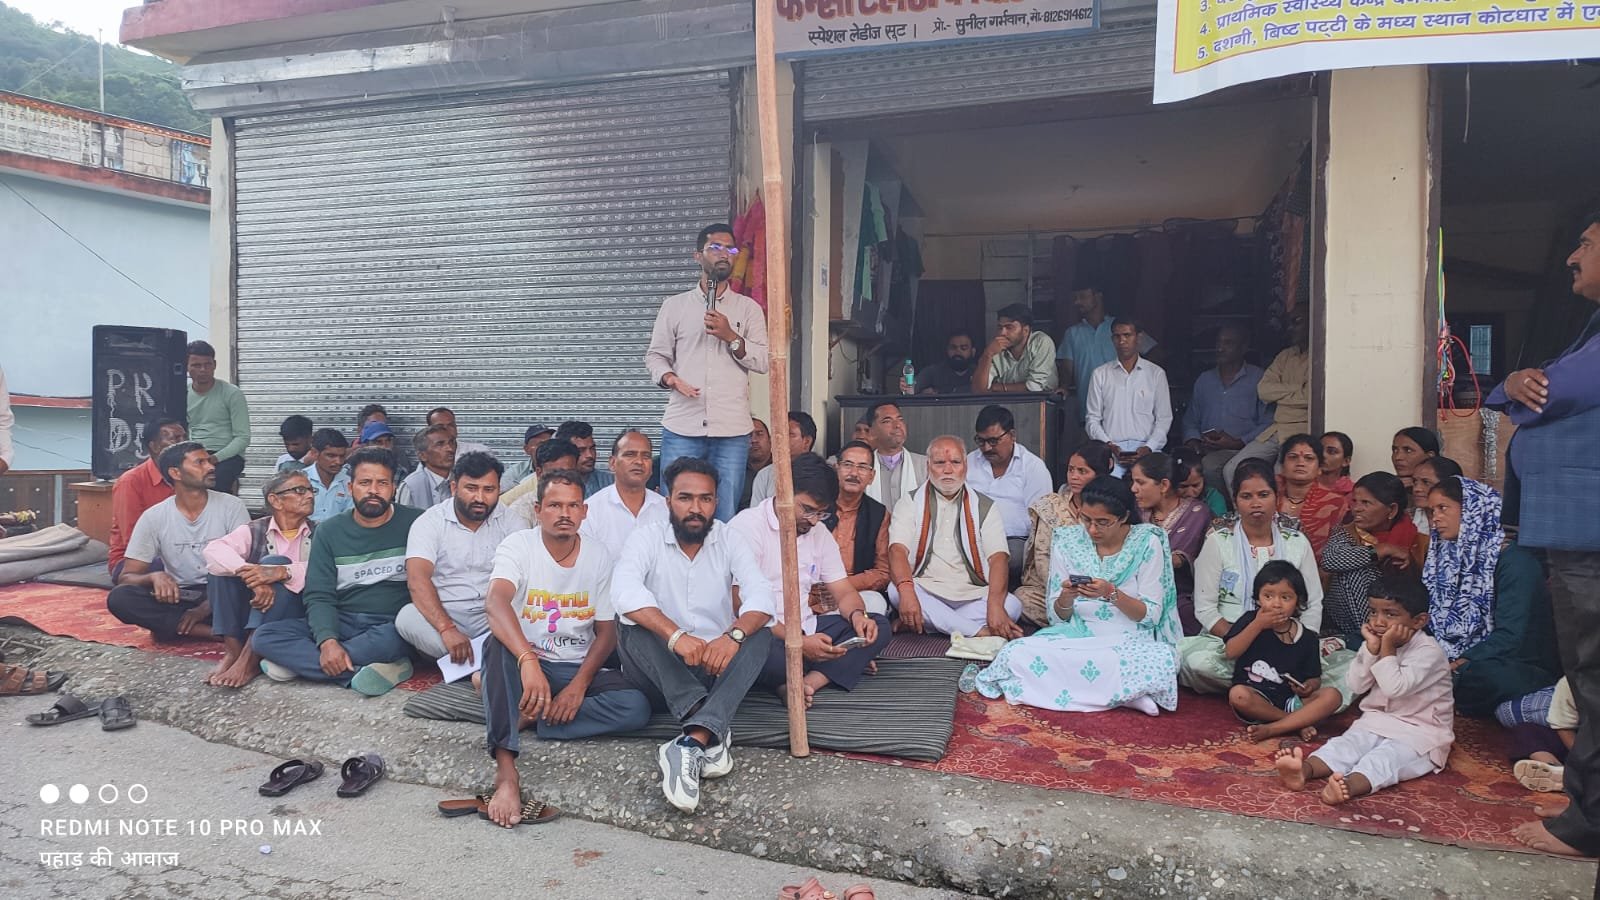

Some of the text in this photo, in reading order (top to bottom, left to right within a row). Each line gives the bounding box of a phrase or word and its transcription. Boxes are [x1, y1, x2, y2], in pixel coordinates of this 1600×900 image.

[956, 13, 986, 35] सुनील
[1217, 3, 1278, 29] प्राथमिक
[1264, 22, 1301, 40] बिष्ट
[1353, 13, 1371, 31] के
[1377, 16, 1417, 30] मध्य
[1423, 13, 1471, 27] स्थान
[1478, 6, 1550, 24] कोटधार
[1556, 1, 1575, 20] में
[1582, 5, 1600, 20] ए
[808, 26, 847, 46] स्पेशल
[850, 22, 881, 42] लेडीज
[354, 565, 392, 579] SPACED
